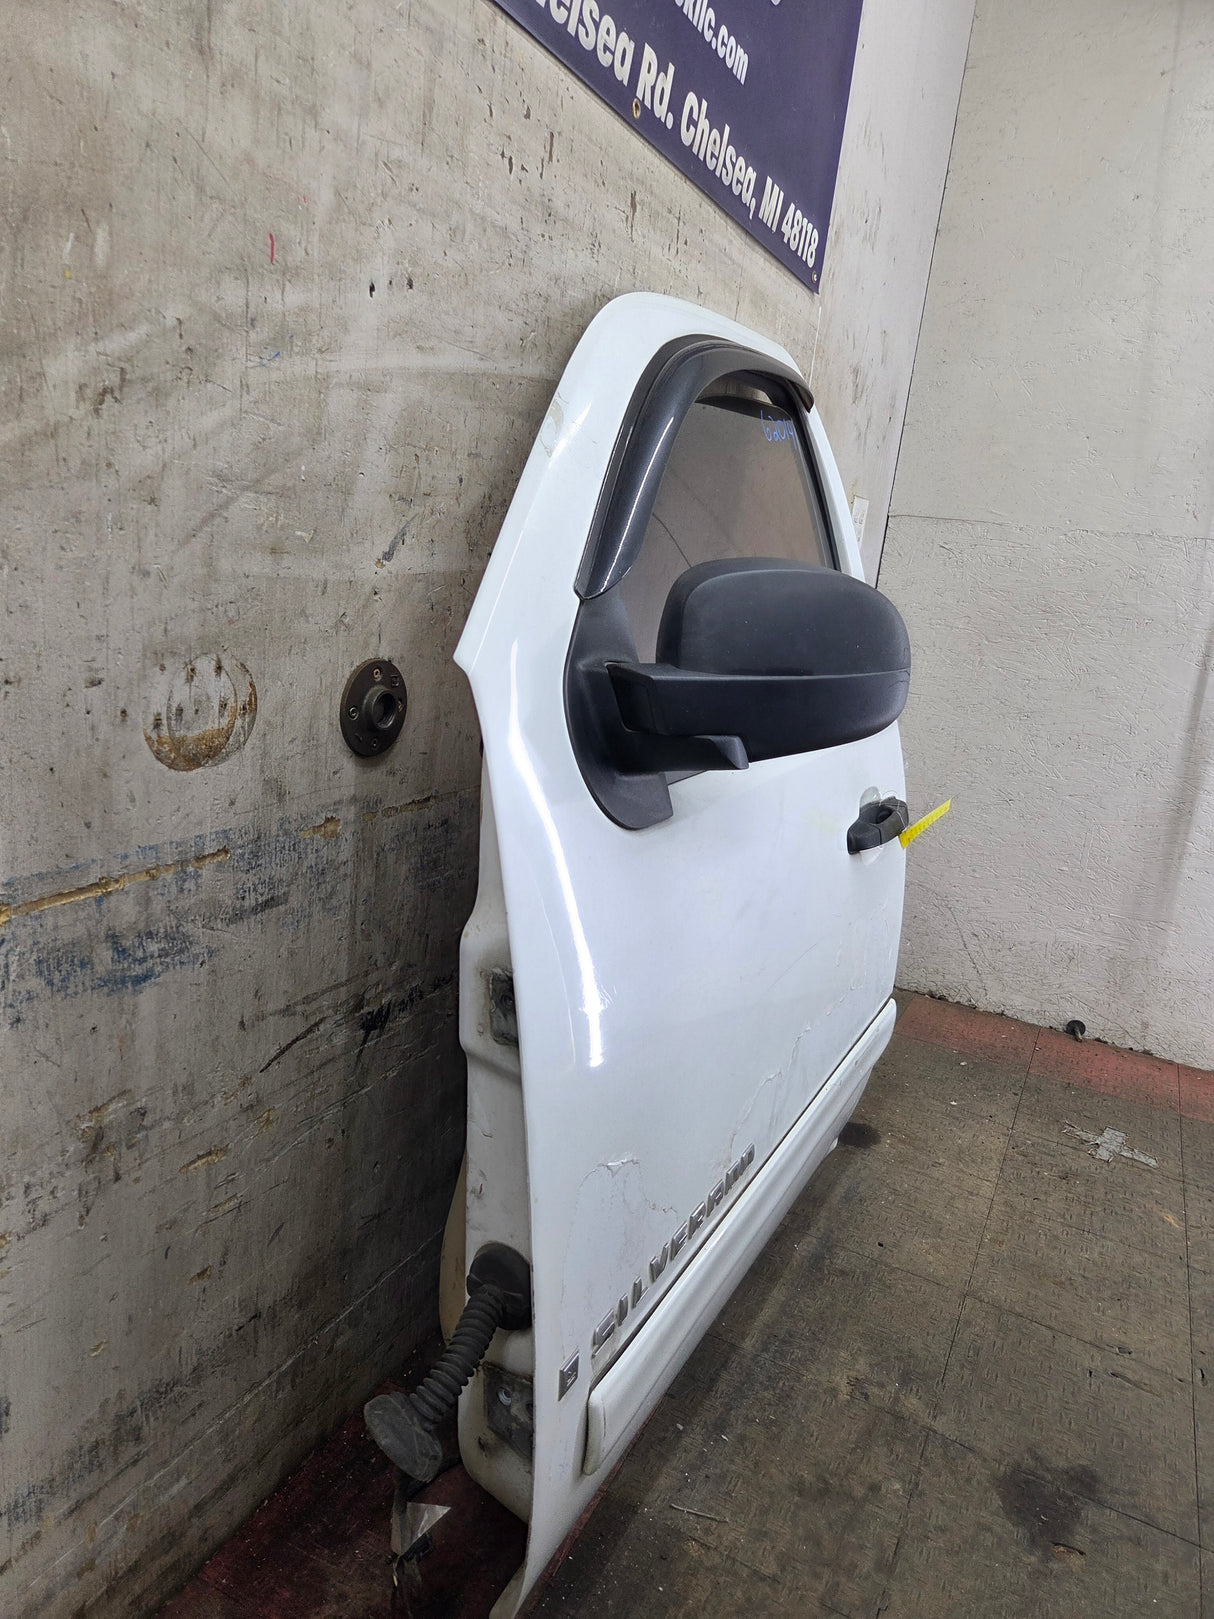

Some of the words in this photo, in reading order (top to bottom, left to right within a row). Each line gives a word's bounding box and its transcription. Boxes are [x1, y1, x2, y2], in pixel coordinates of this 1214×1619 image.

[535, 0, 635, 87] elsea
[636, 42, 675, 129] Rd.
[680, 91, 757, 220] Chelsea,
[758, 176, 784, 232] MI
[781, 202, 819, 268] 48118
[675, 0, 749, 85] llc.com
[591, 1142, 755, 1358] SILVERADO
